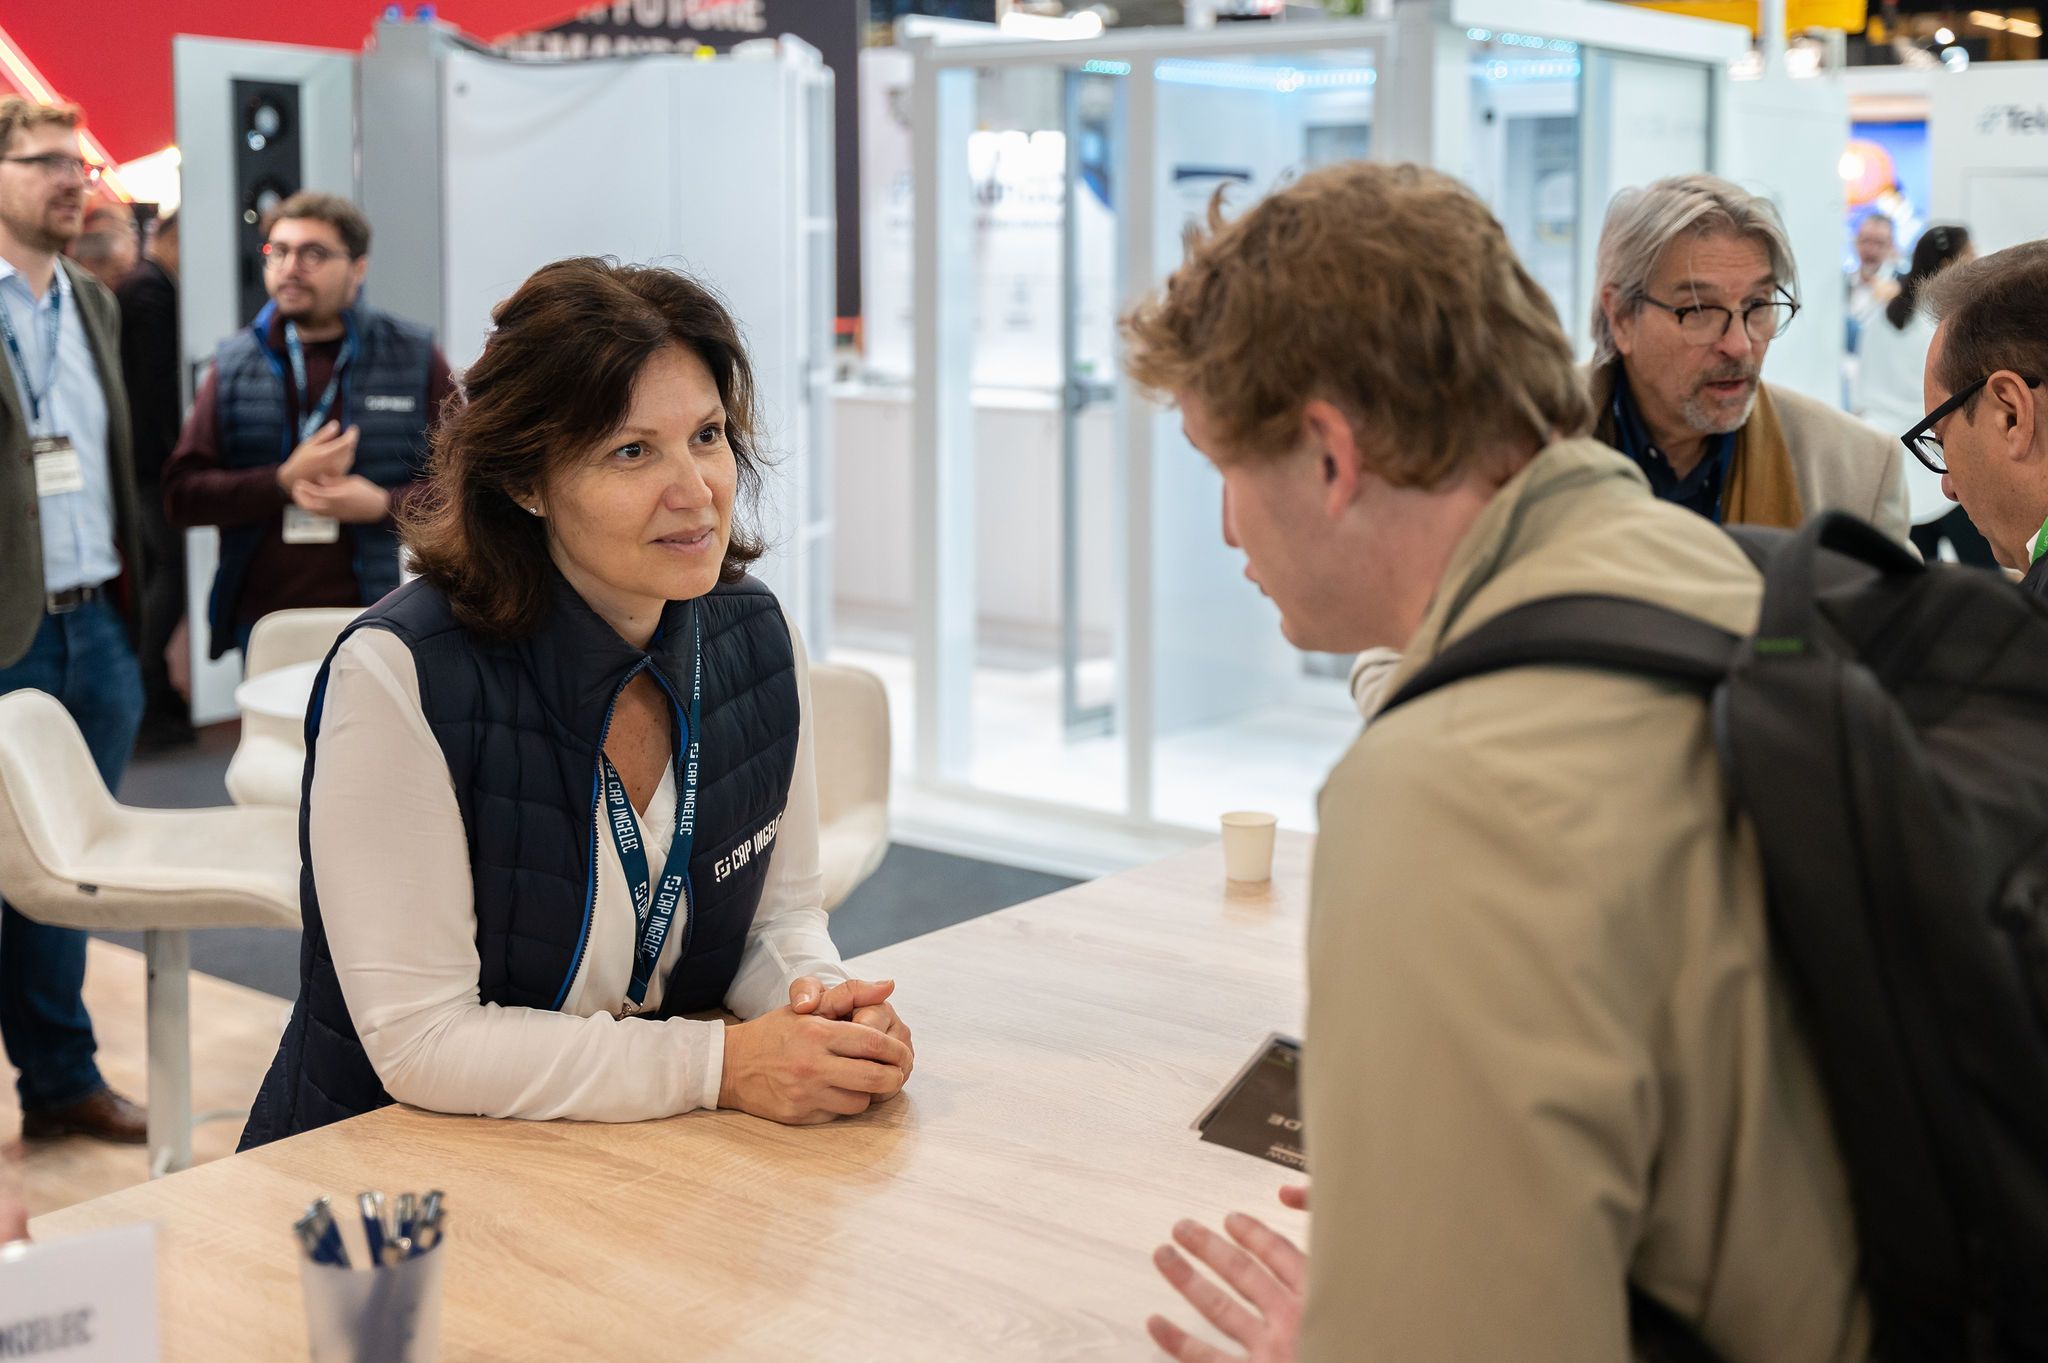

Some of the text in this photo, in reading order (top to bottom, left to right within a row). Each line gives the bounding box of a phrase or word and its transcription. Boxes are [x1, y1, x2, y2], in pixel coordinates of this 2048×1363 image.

[608, 781, 639, 854] CAP INGELEC
[679, 762, 698, 836] CAP INGELEC
[732, 839, 752, 870] CAP
[641, 892, 676, 958] CAP INGELEC
